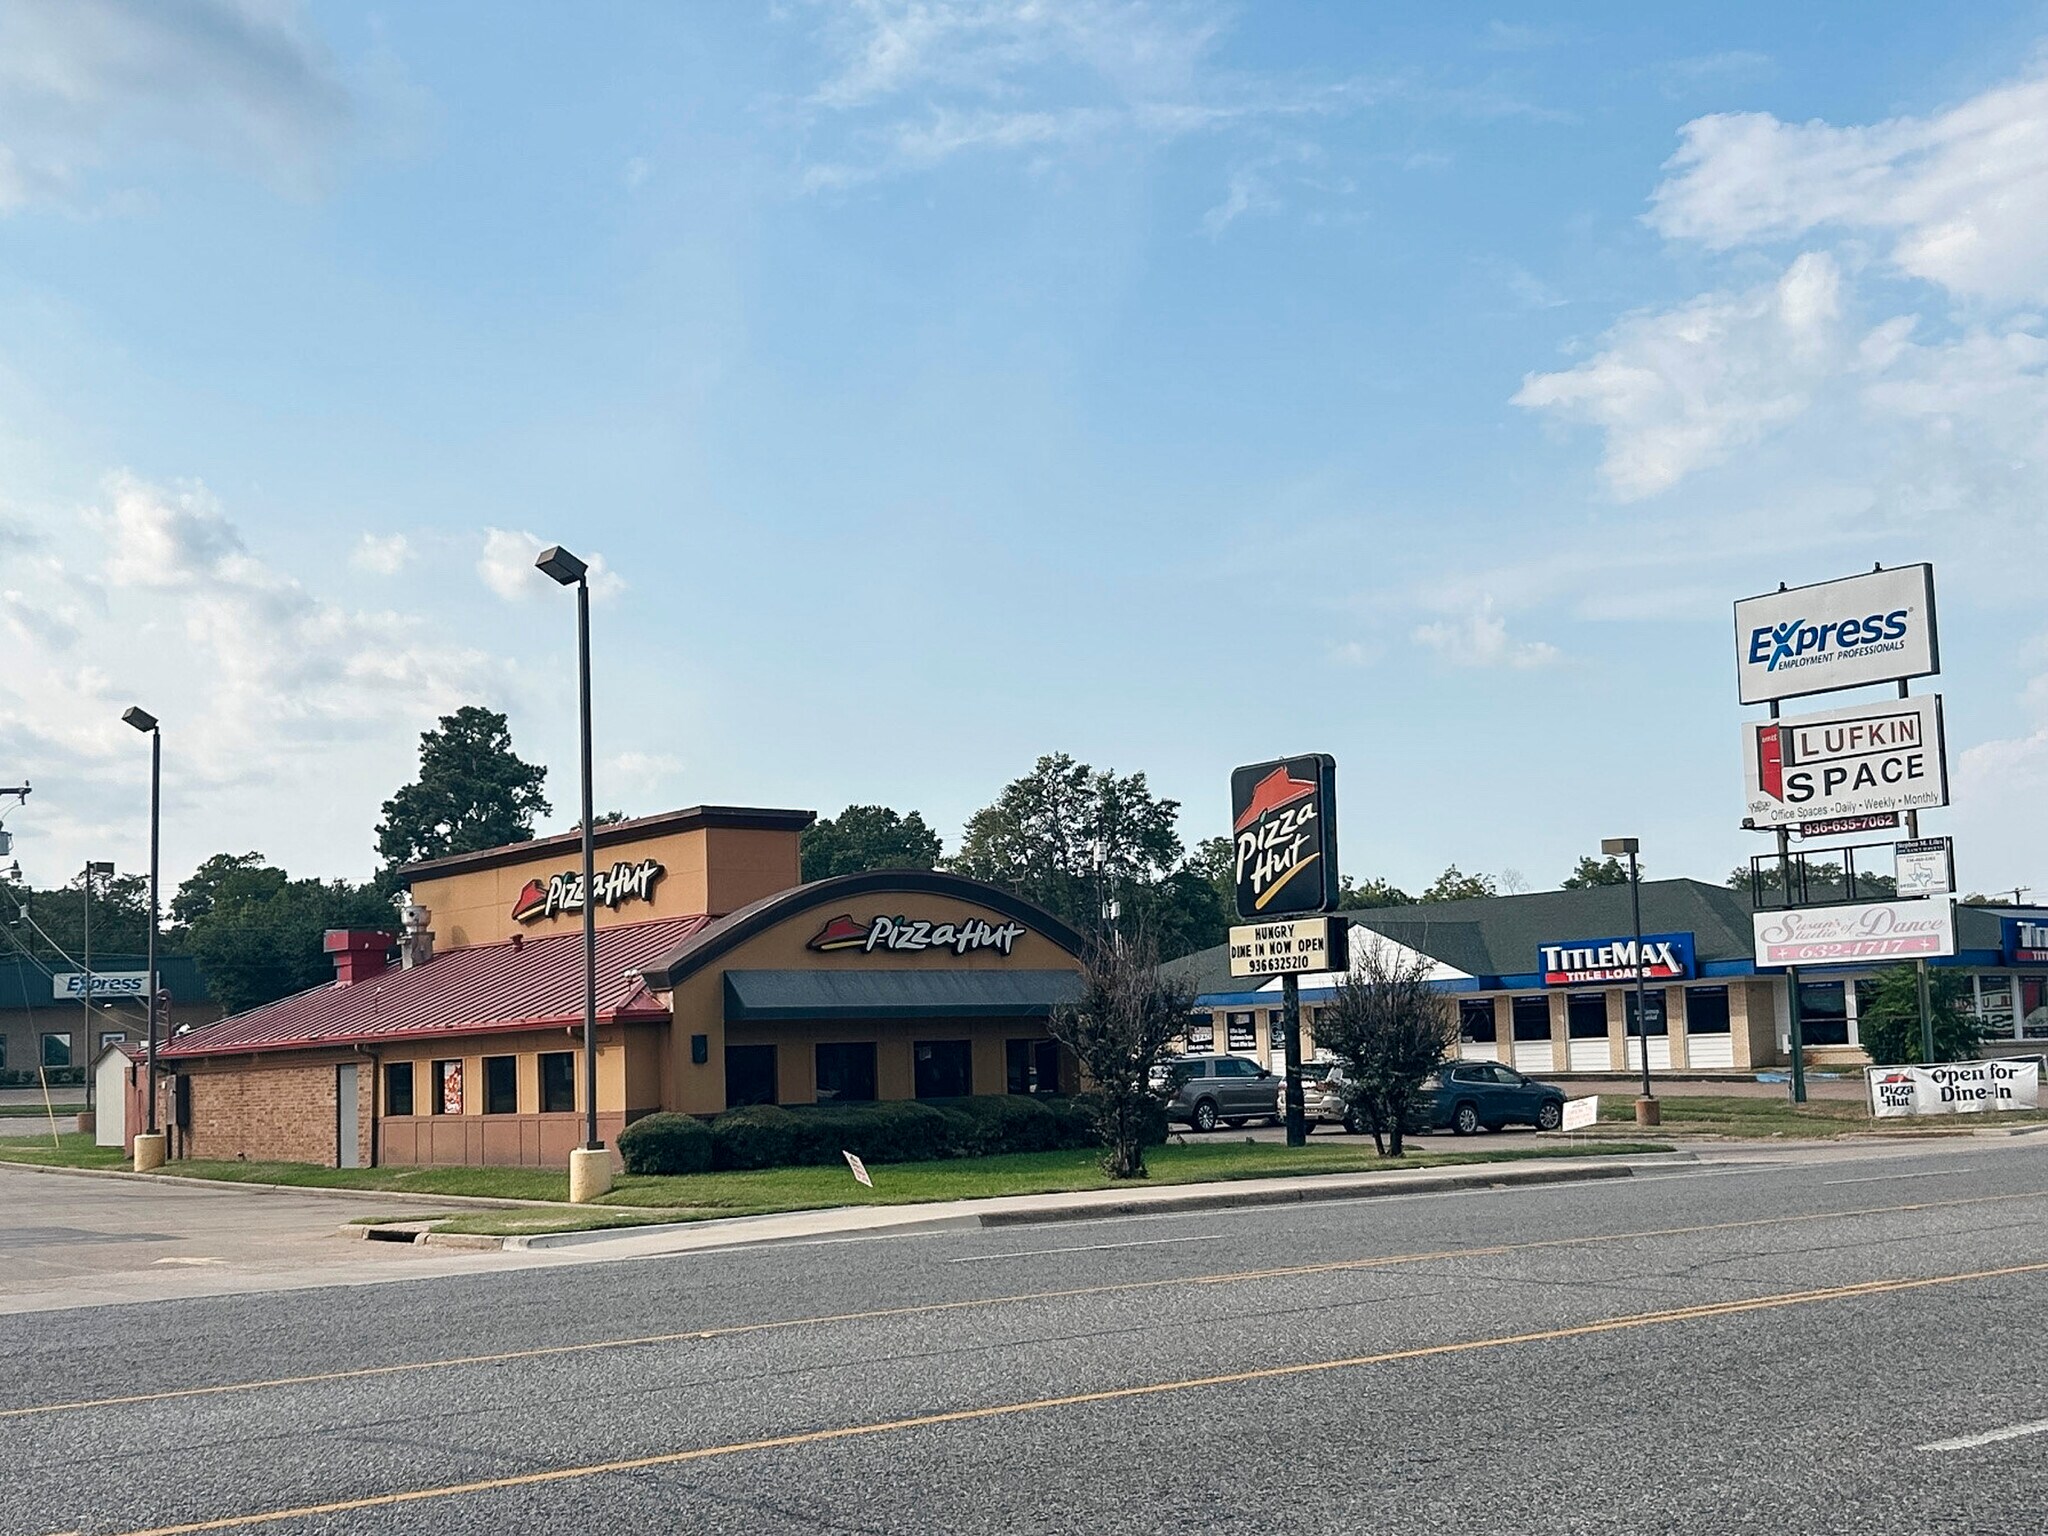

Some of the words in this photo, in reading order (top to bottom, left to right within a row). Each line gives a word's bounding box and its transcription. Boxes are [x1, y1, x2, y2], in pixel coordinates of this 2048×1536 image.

[1748, 610, 1908, 672] Express
[1778, 653, 1834, 671] EMPLOYMENT
[1837, 640, 1905, 660] PROFESSIONALS
[1801, 719, 1914, 757] LUFKIN
[1786, 753, 1924, 803] SPACE
[1771, 809, 1795, 821] Office
[1797, 805, 1828, 819] Spaces
[1835, 801, 1856, 815] Daily
[1864, 797, 1895, 810] Weekly
[1904, 791, 1939, 806] Monthly
[1804, 814, 1894, 835] 936-635-7062
[1236, 802, 1318, 885] Pizza
[1250, 833, 1311, 894] Hut
[605, 861, 658, 906] Hut
[866, 915, 957, 952] Pizza
[955, 918, 1027, 953] Hut
[1255, 924, 1295, 940] HUNGRY
[1855, 906, 1945, 938] Dance
[1231, 944, 1251, 959] DINE
[1255, 943, 1265, 956] IN
[1269, 940, 1291, 955] NOW
[1298, 937, 1324, 952] OPEN
[1249, 955, 1309, 972] 9366325210
[1566, 970, 1602, 982] TITLE
[1931, 1067, 1985, 1086] Open
[1990, 1063, 2019, 1080] for
[1880, 1084, 1914, 1097] Pizza
[1882, 1096, 1910, 1107] Hut
[1941, 1082, 2012, 1102] Dine-In
